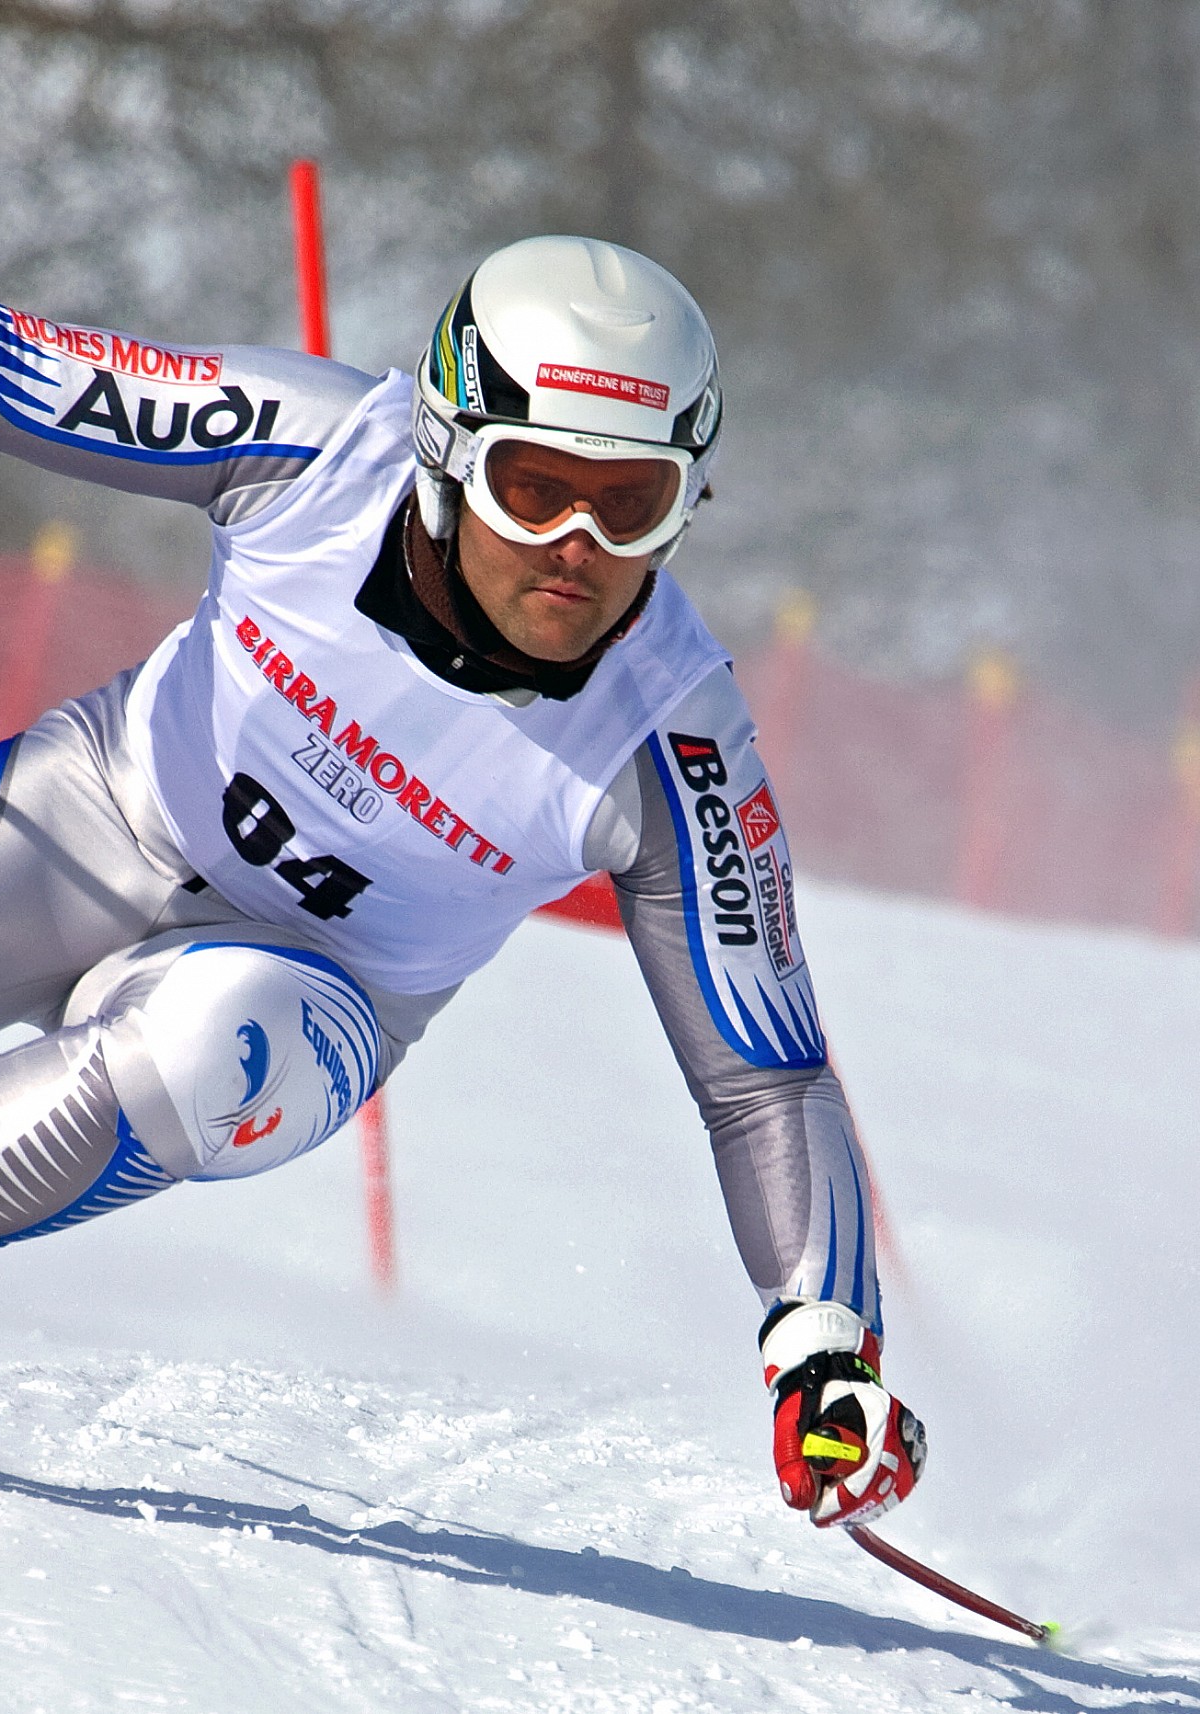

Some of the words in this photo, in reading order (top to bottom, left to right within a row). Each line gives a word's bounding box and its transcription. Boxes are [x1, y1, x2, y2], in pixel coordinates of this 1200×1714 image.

[111, 335, 220, 382] MONTS
[539, 366, 550, 380] IN
[620, 380, 637, 395] WE
[638, 383, 667, 401] TRUST
[55, 368, 281, 451] Audi
[235, 615, 338, 739] BIRRA
[333, 719, 517, 877] MORETTI
[291, 733, 384, 824] ZERO
[667, 732, 759, 948] Besson
[754, 852, 791, 972] D'EPARGNE
[781, 862, 796, 938] CAISSE
